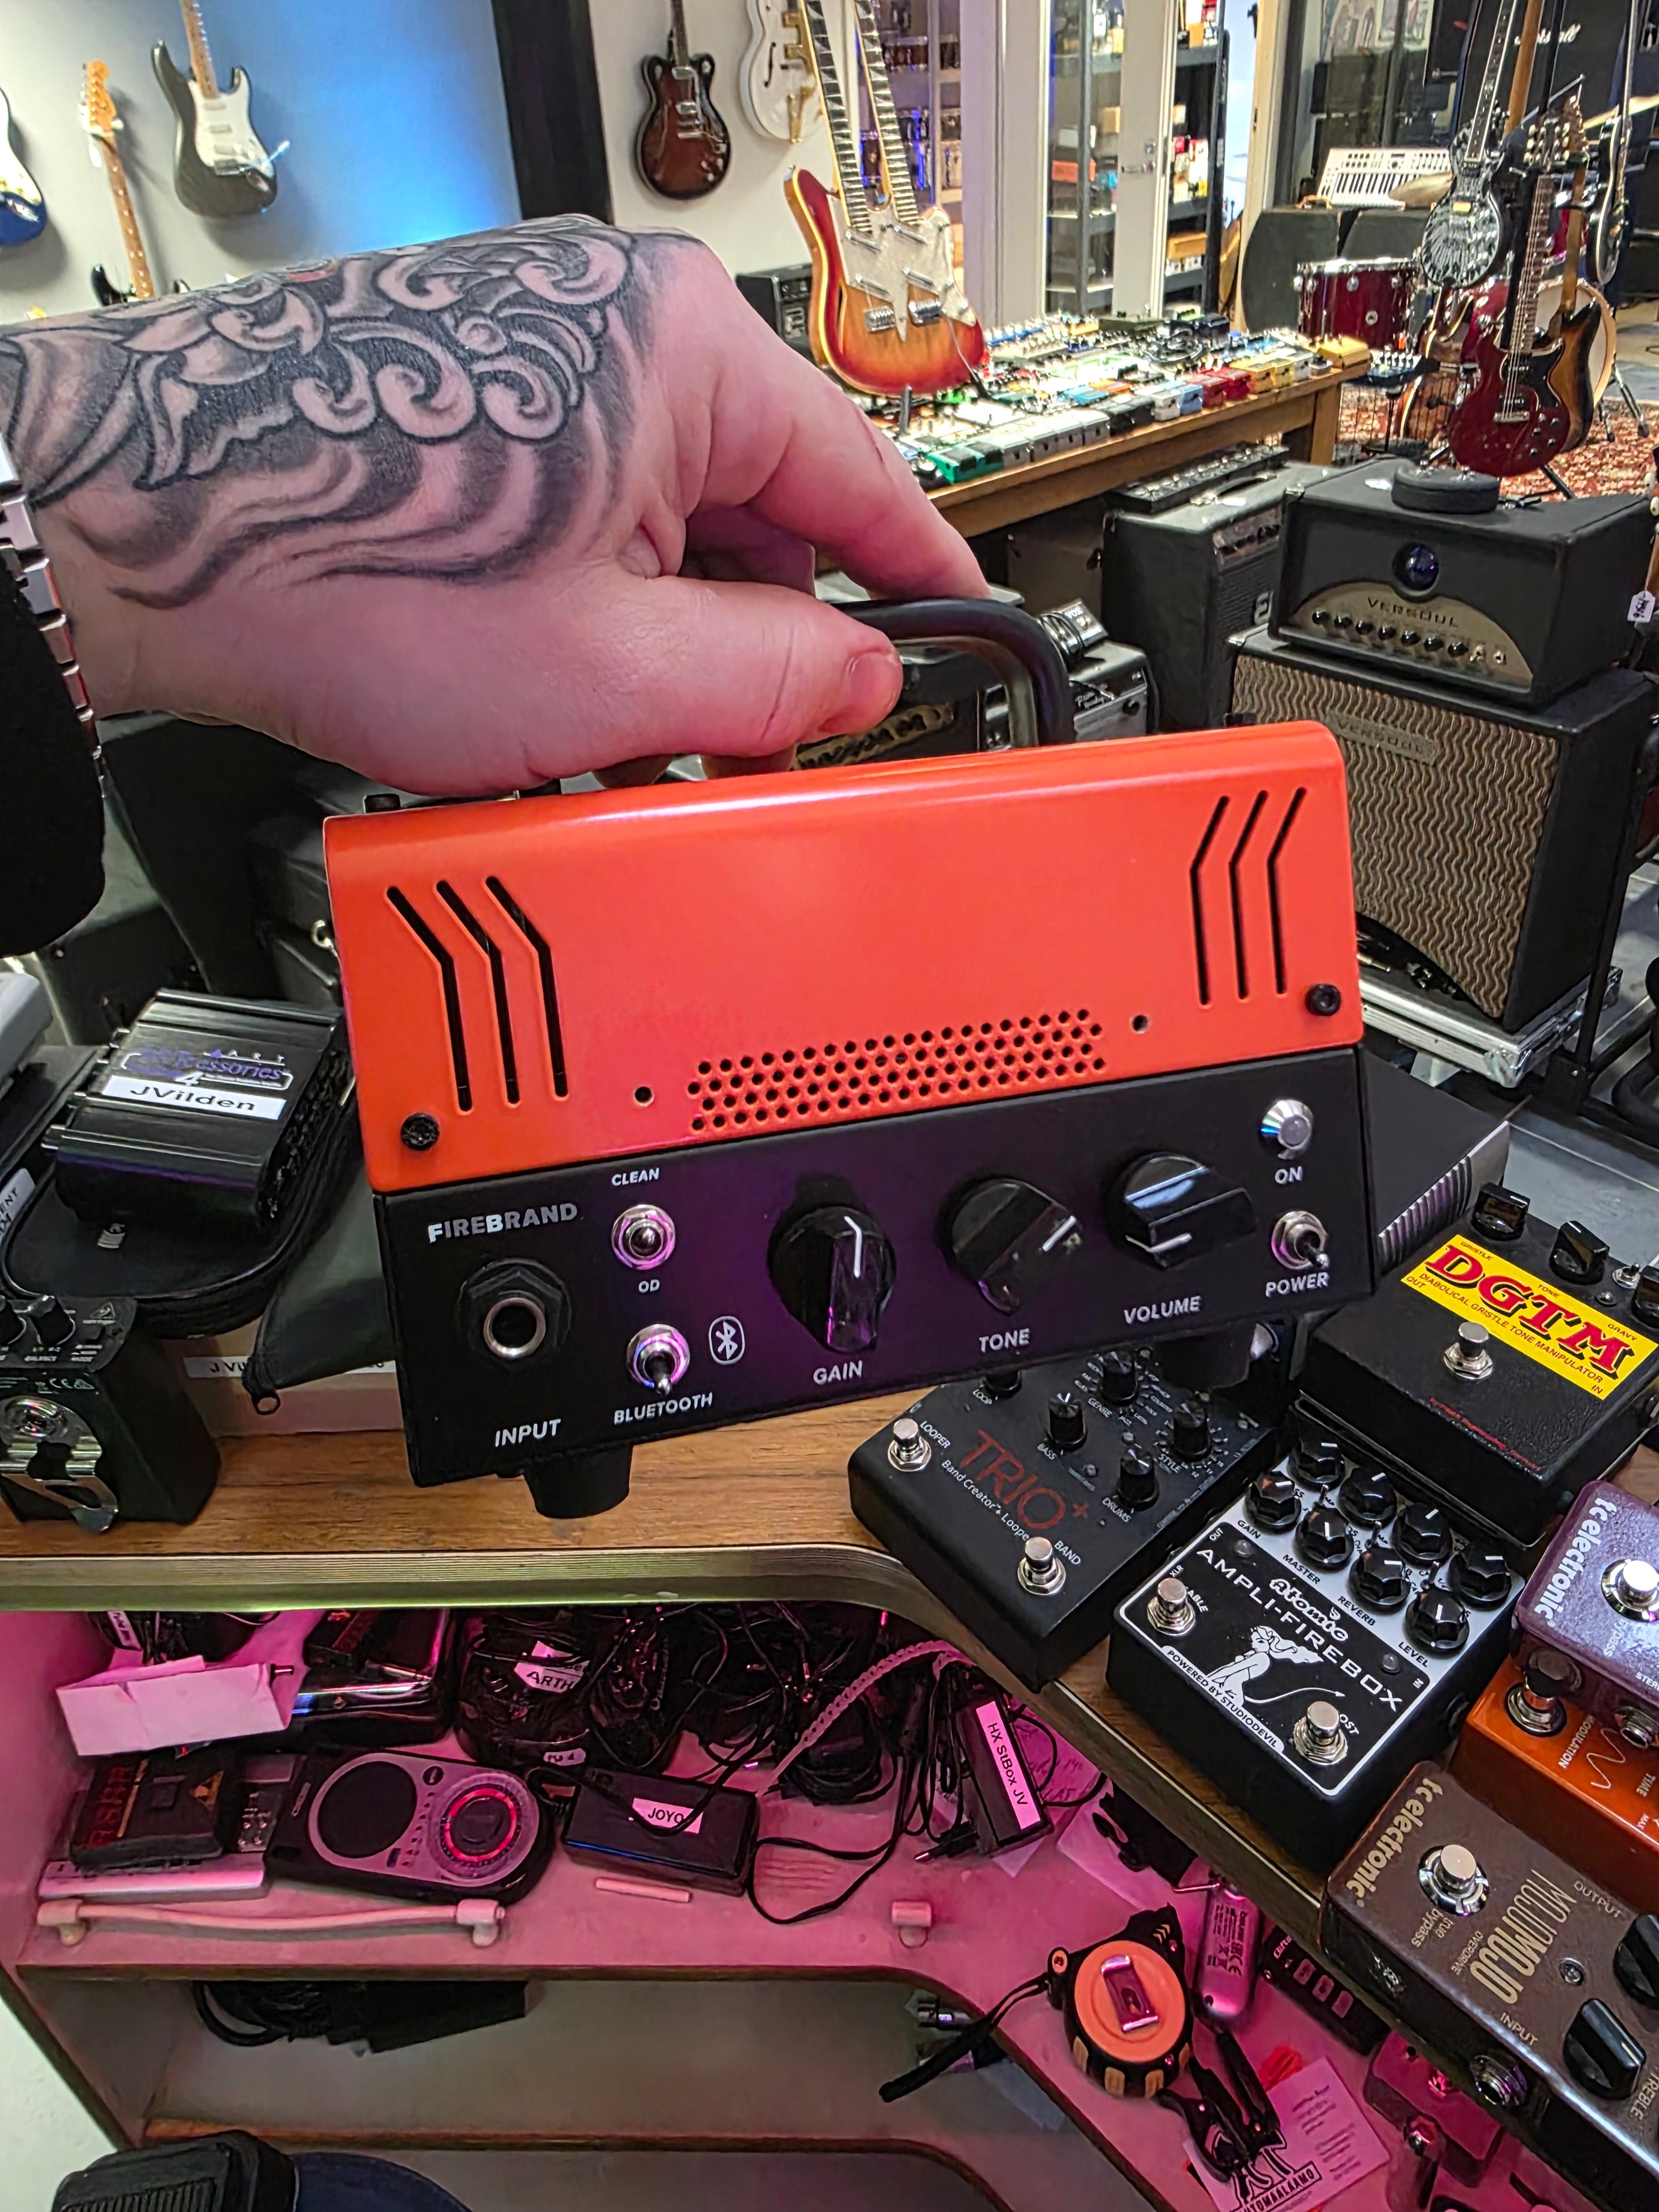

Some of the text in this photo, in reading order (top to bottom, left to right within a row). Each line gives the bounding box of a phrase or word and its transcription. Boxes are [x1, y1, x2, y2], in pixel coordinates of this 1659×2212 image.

[131, 1086, 255, 1110] JVilden
[612, 1167, 660, 1187] CLEAN
[1274, 1166, 1303, 1185] ON
[427, 1202, 578, 1244] FIREBRAND
[638, 1279, 660, 1293] OD
[1265, 1272, 1329, 1297] POWER
[1406, 1276, 1427, 1289] OUT
[1537, 1284, 1561, 1298] TONE
[1123, 1296, 1201, 1324] VOLUME
[1424, 1244, 1636, 1380] DGTM
[979, 1328, 1030, 1352] TONE
[1418, 1272, 1604, 1384] DIABOLICAL GRISTLE TONE MANIPULATOR
[1607, 1323, 1638, 1342] GRAVY
[813, 1360, 863, 1385] GAIN
[973, 1389, 993, 1405] LOOP
[1590, 1384, 1604, 1395] IN
[613, 1392, 713, 1425] BLUETOOTH
[1088, 1397, 1113, 1418] GENRE
[494, 1418, 561, 1447] INPUT
[920, 1421, 951, 1449] LOOPER
[1037, 1443, 1058, 1460] BASS
[1158, 1453, 1182, 1474] STYLE
[941, 1459, 967, 1483] Band
[1001, 1513, 1030, 1541] Loope
[1102, 1496, 1133, 1524] DRUMS
[1209, 1528, 1224, 1542] OUT
[1237, 1519, 1262, 1540] GAIN
[1055, 1540, 1082, 1566] BAND
[1535, 1497, 1618, 1620] tc electronic
[1169, 1564, 1185, 1578] XLR
[1282, 1553, 1322, 1585] MASTER
[1270, 1577, 1349, 1642] Atomic
[1337, 1595, 1376, 1626] REVERB
[1397, 1641, 1429, 1668] LEVEL
[1412, 1677, 1425, 1690] IN
[1165, 1649, 1279, 1749] POWERED BY STUDIODEVIL
[987, 1723, 1003, 1744] HX
[1013, 1788, 1029, 1806] JV
[1635, 1772, 1656, 1797] TIME
[648, 1807, 686, 1824] JOYO
[1345, 1777, 1444, 1900] tc electronic
[1573, 1880, 1624, 1919] OUTPUT
[1410, 1907, 1443, 1949] bypass
[1469, 1868, 1578, 2005] MOJOMOJO
[1451, 1930, 1484, 1976] OVERDRIVE
[1499, 2011, 1538, 2046] INPUT
[1630, 2072, 1659, 2120] TREBLE
